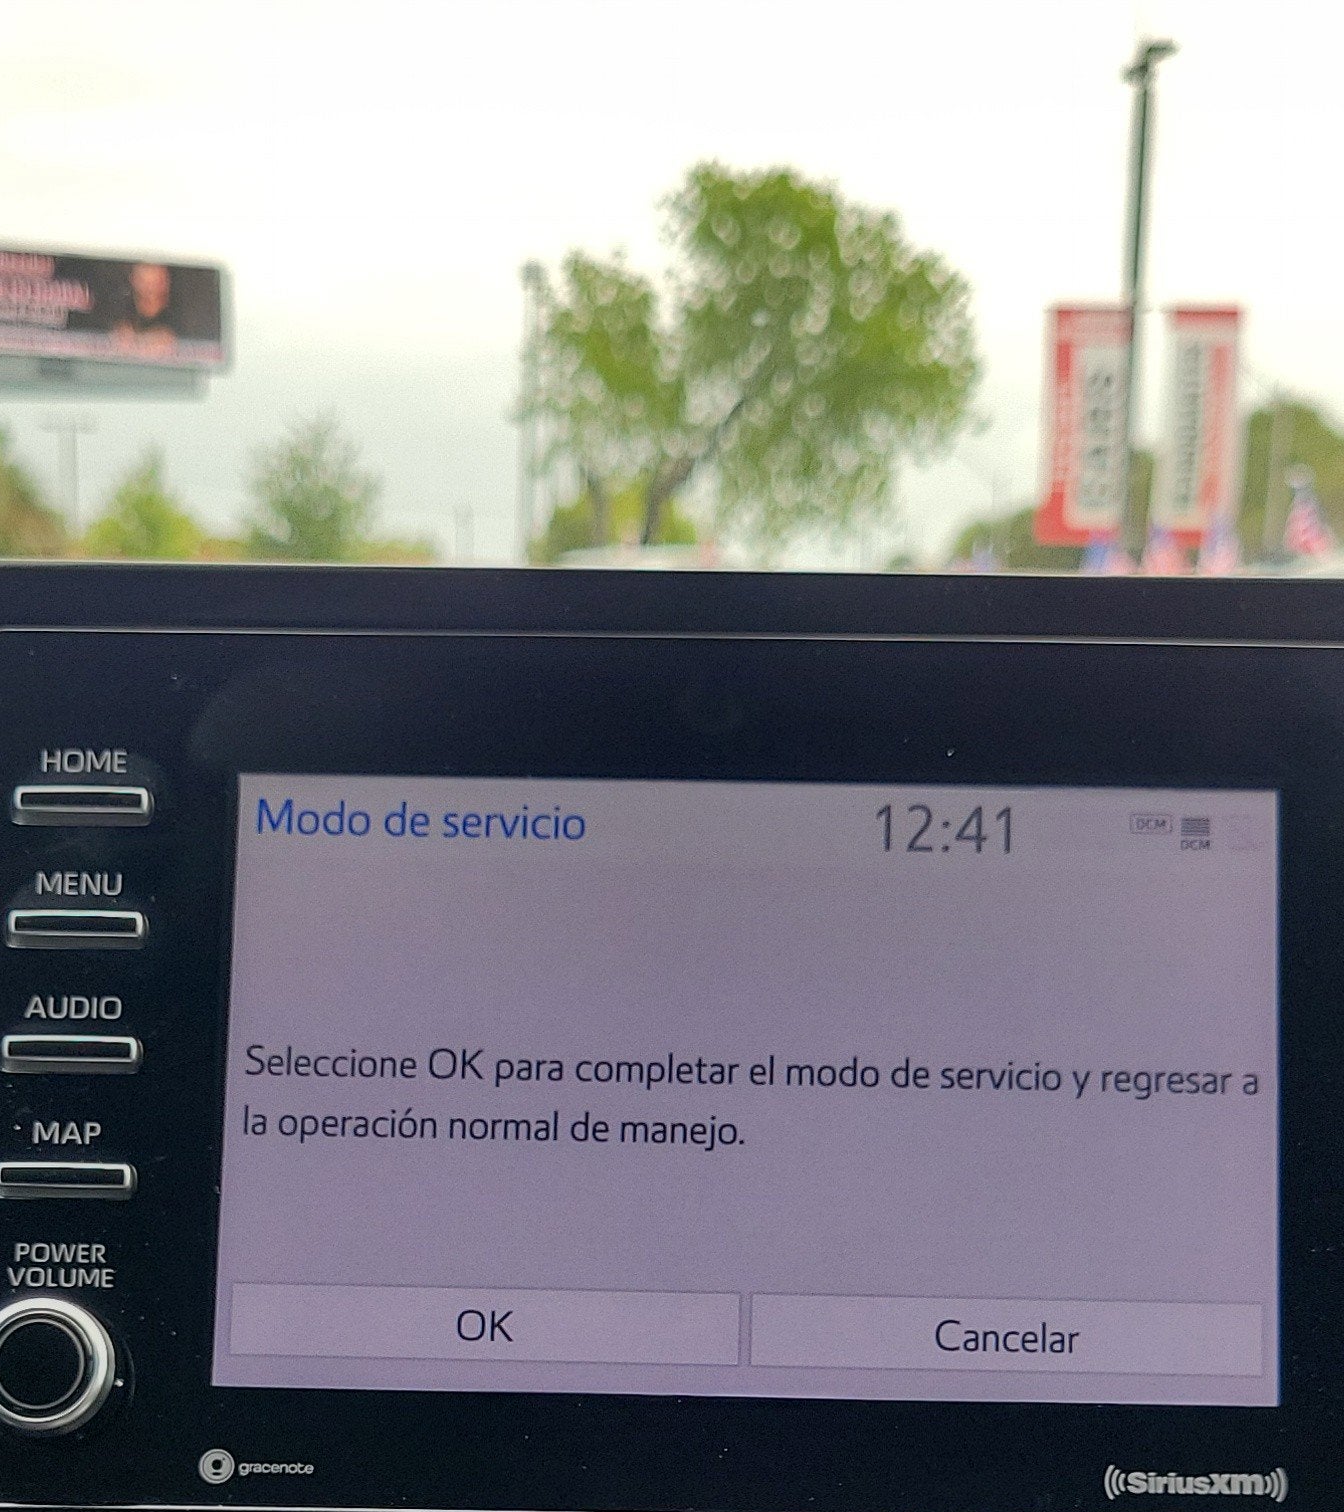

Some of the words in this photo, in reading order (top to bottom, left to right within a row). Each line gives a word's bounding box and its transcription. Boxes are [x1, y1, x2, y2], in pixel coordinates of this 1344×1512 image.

[41, 749, 128, 773] HOME
[255, 797, 372, 838] Modo
[382, 799, 432, 839] de
[442, 804, 586, 842] servicio
[874, 803, 1015, 855] 12:41
[35, 871, 123, 896] MENU
[24, 996, 122, 1020] AUDIO
[243, 1044, 418, 1081] Seleccione
[427, 1046, 484, 1081] OK
[494, 1058, 564, 1092] para
[574, 1052, 740, 1095] completar
[748, 1055, 777, 1086] el
[785, 1055, 881, 1089] modo
[889, 1057, 931, 1089] de
[939, 1060, 1063, 1092] servicio
[1073, 1072, 1091, 1100] y
[1101, 1069, 1233, 1100] regresar
[1243, 1072, 1260, 1094] a
[32, 1121, 102, 1145] MAP
[243, 1105, 268, 1137] la
[277, 1107, 439, 1142] operación
[448, 1111, 560, 1142] normal
[569, 1112, 612, 1144] de
[619, 1116, 746, 1152] manejo.
[14, 1243, 106, 1263] POWER
[7, 1267, 116, 1289] VOLUME
[455, 1308, 514, 1344] OK
[934, 1318, 1080, 1354] Cancelar
[238, 1459, 315, 1477] gracenote
